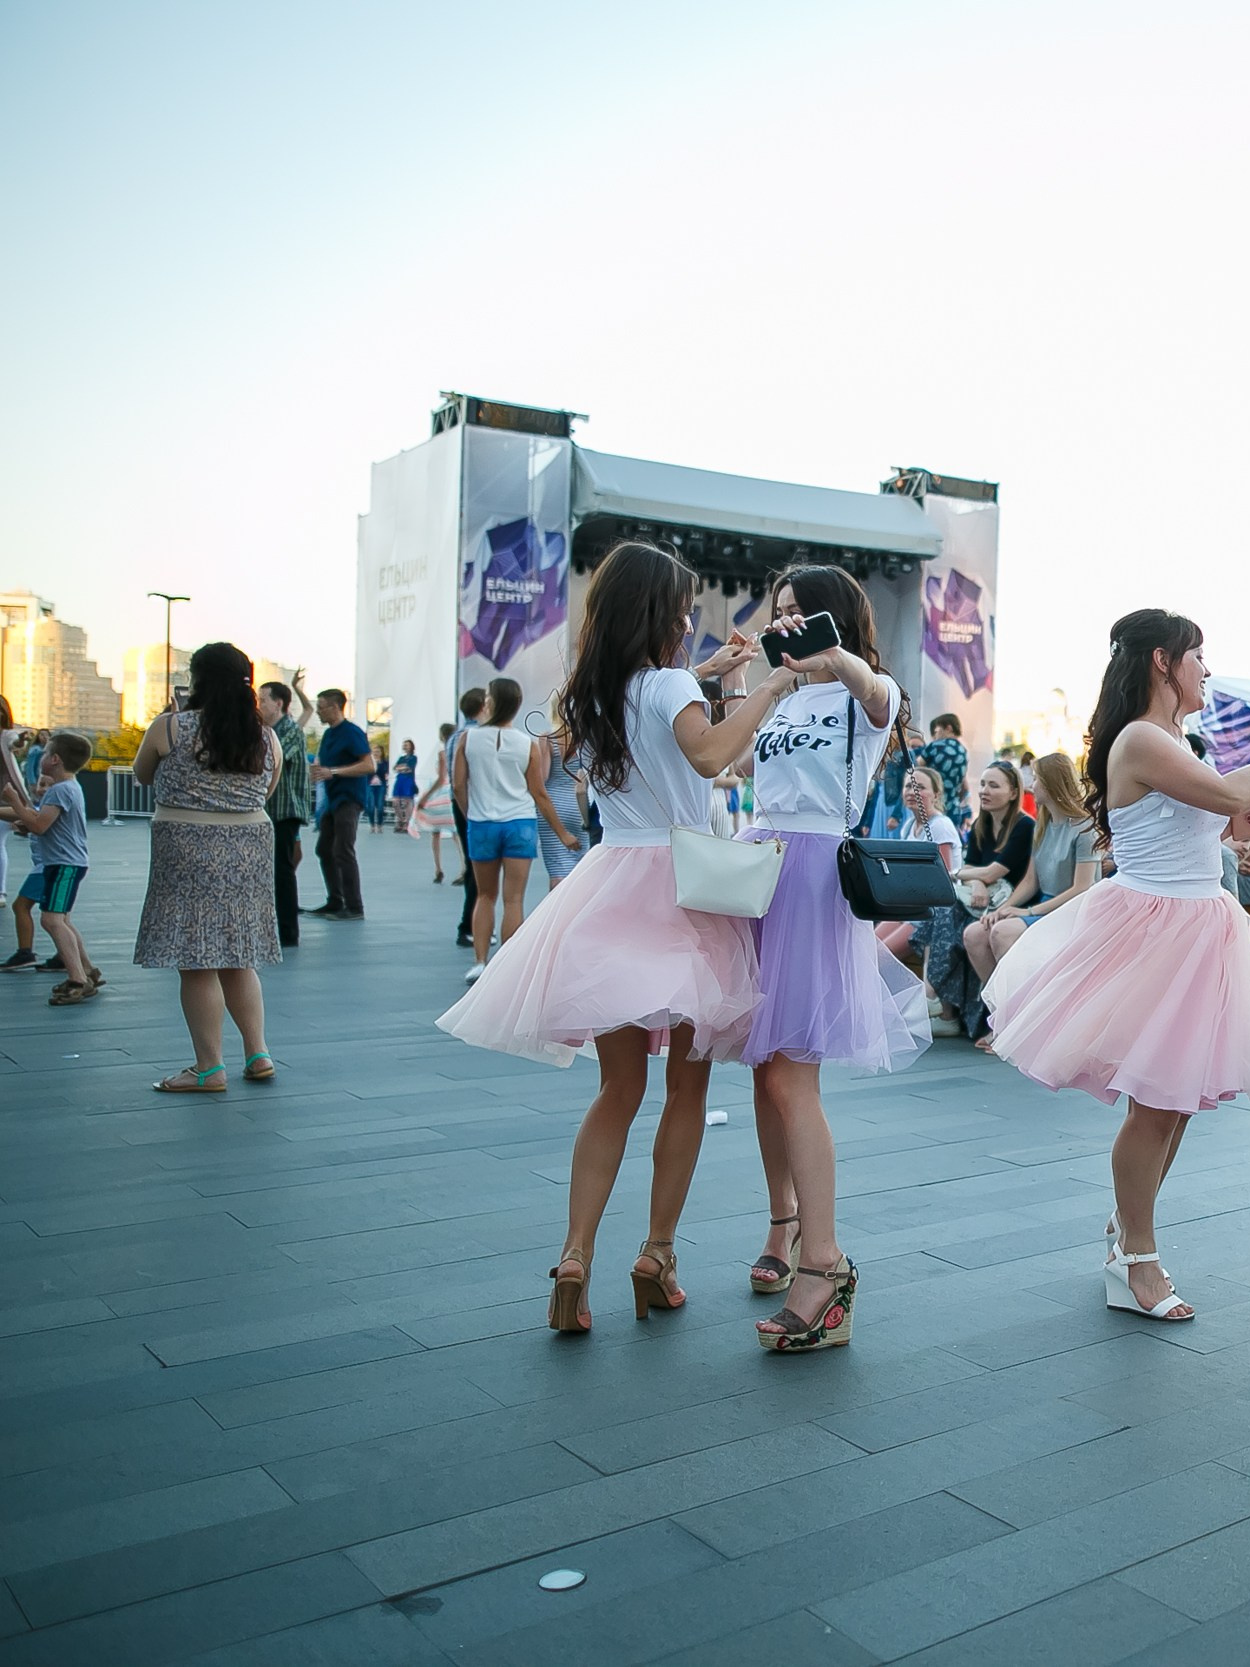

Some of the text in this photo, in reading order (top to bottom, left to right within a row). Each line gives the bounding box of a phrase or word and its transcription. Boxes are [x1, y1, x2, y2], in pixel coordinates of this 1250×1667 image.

[379, 555, 428, 592] ЕЛЬЦИН
[486, 577, 545, 594] ЕЛЬЦИН
[486, 590, 533, 604] ЦЕНТР
[378, 595, 415, 628] ЦЕНТР
[939, 622, 981, 635] ЕЛЬЦИН
[939, 632, 973, 643] ЦЕНТР
